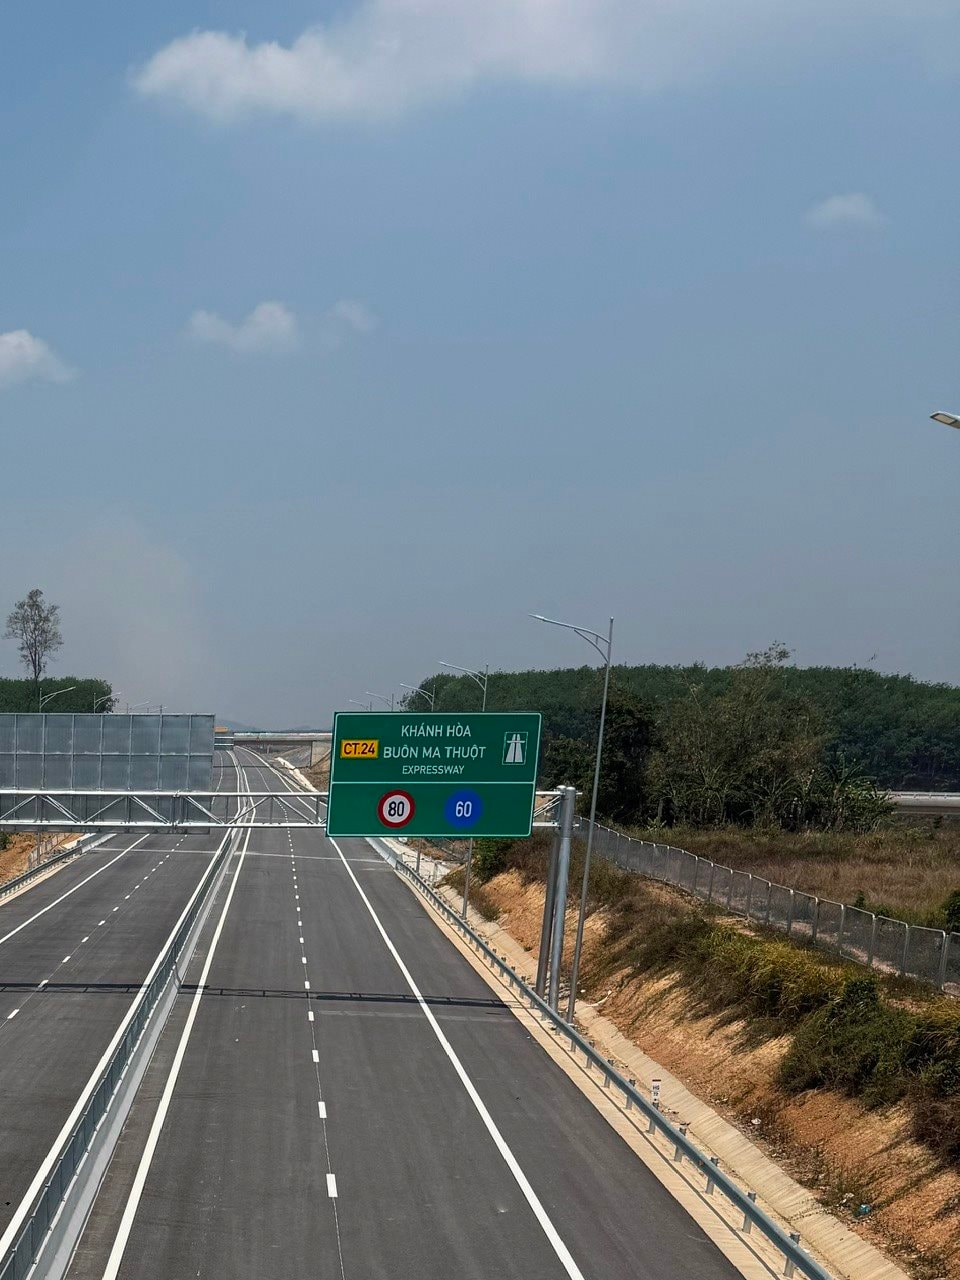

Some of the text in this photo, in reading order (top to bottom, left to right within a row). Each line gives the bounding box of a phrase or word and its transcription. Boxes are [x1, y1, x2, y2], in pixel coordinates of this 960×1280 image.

[401, 722, 471, 737] KHÁNH HÒA
[343, 742, 375, 755] CT.24
[383, 744, 487, 761] BUÔN MA THUỘT
[402, 765, 465, 775] EXPRESSWAY
[387, 801, 405, 817] 80
[455, 801, 472, 817] 60
